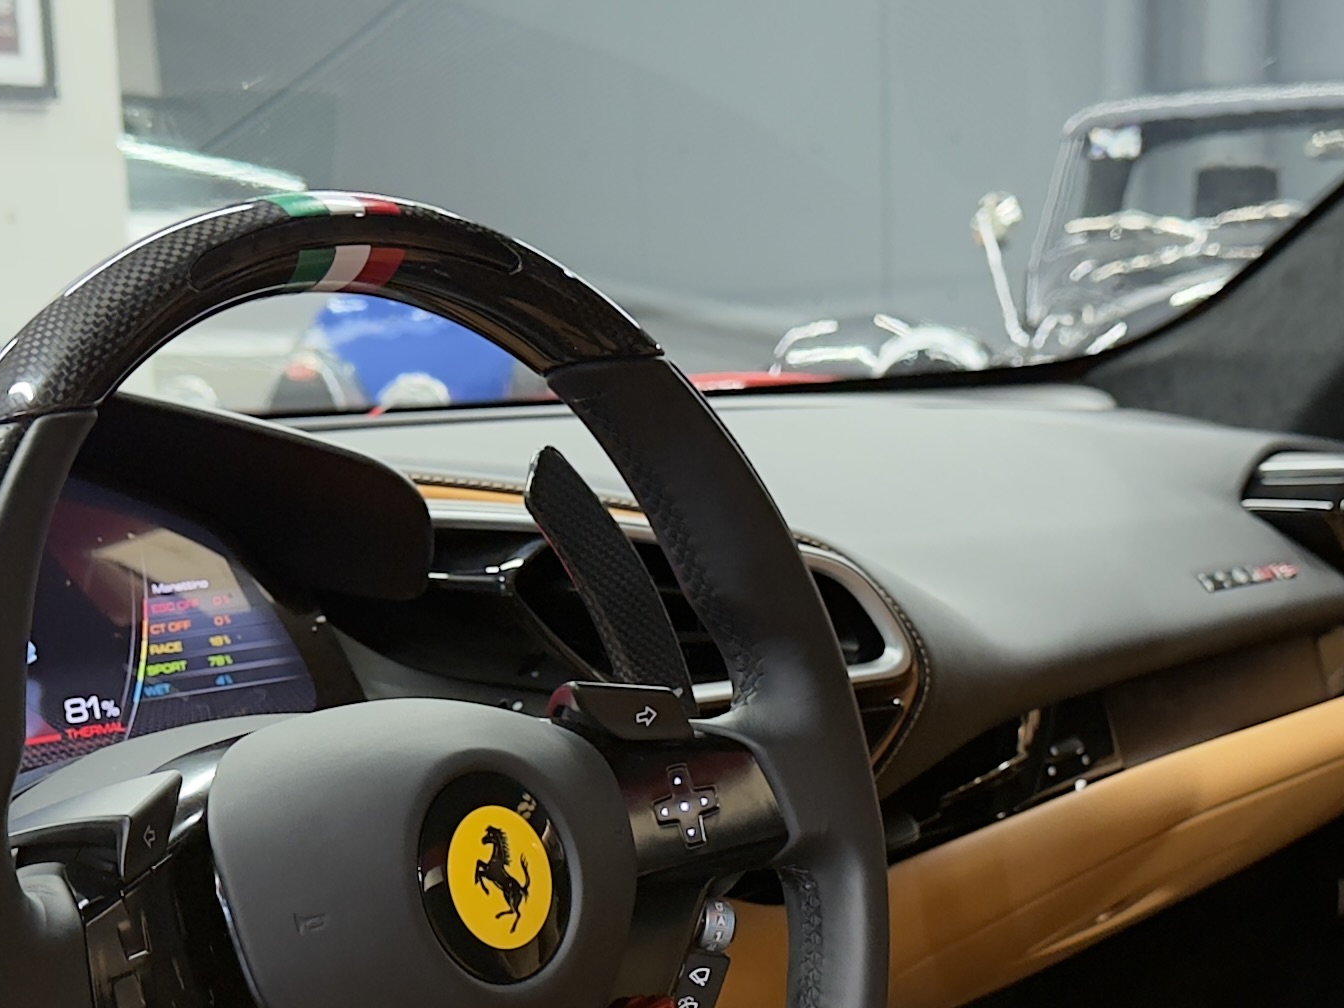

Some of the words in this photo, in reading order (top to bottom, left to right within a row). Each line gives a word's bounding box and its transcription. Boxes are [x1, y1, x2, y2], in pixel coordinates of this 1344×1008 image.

[150, 623, 167, 635] CT
[167, 619, 192, 633] OFF
[149, 641, 184, 656] RACE
[145, 660, 188, 677] SPORT
[143, 682, 172, 697] WET
[64, 695, 121, 724] 81%
[64, 721, 127, 739] THERMAL
